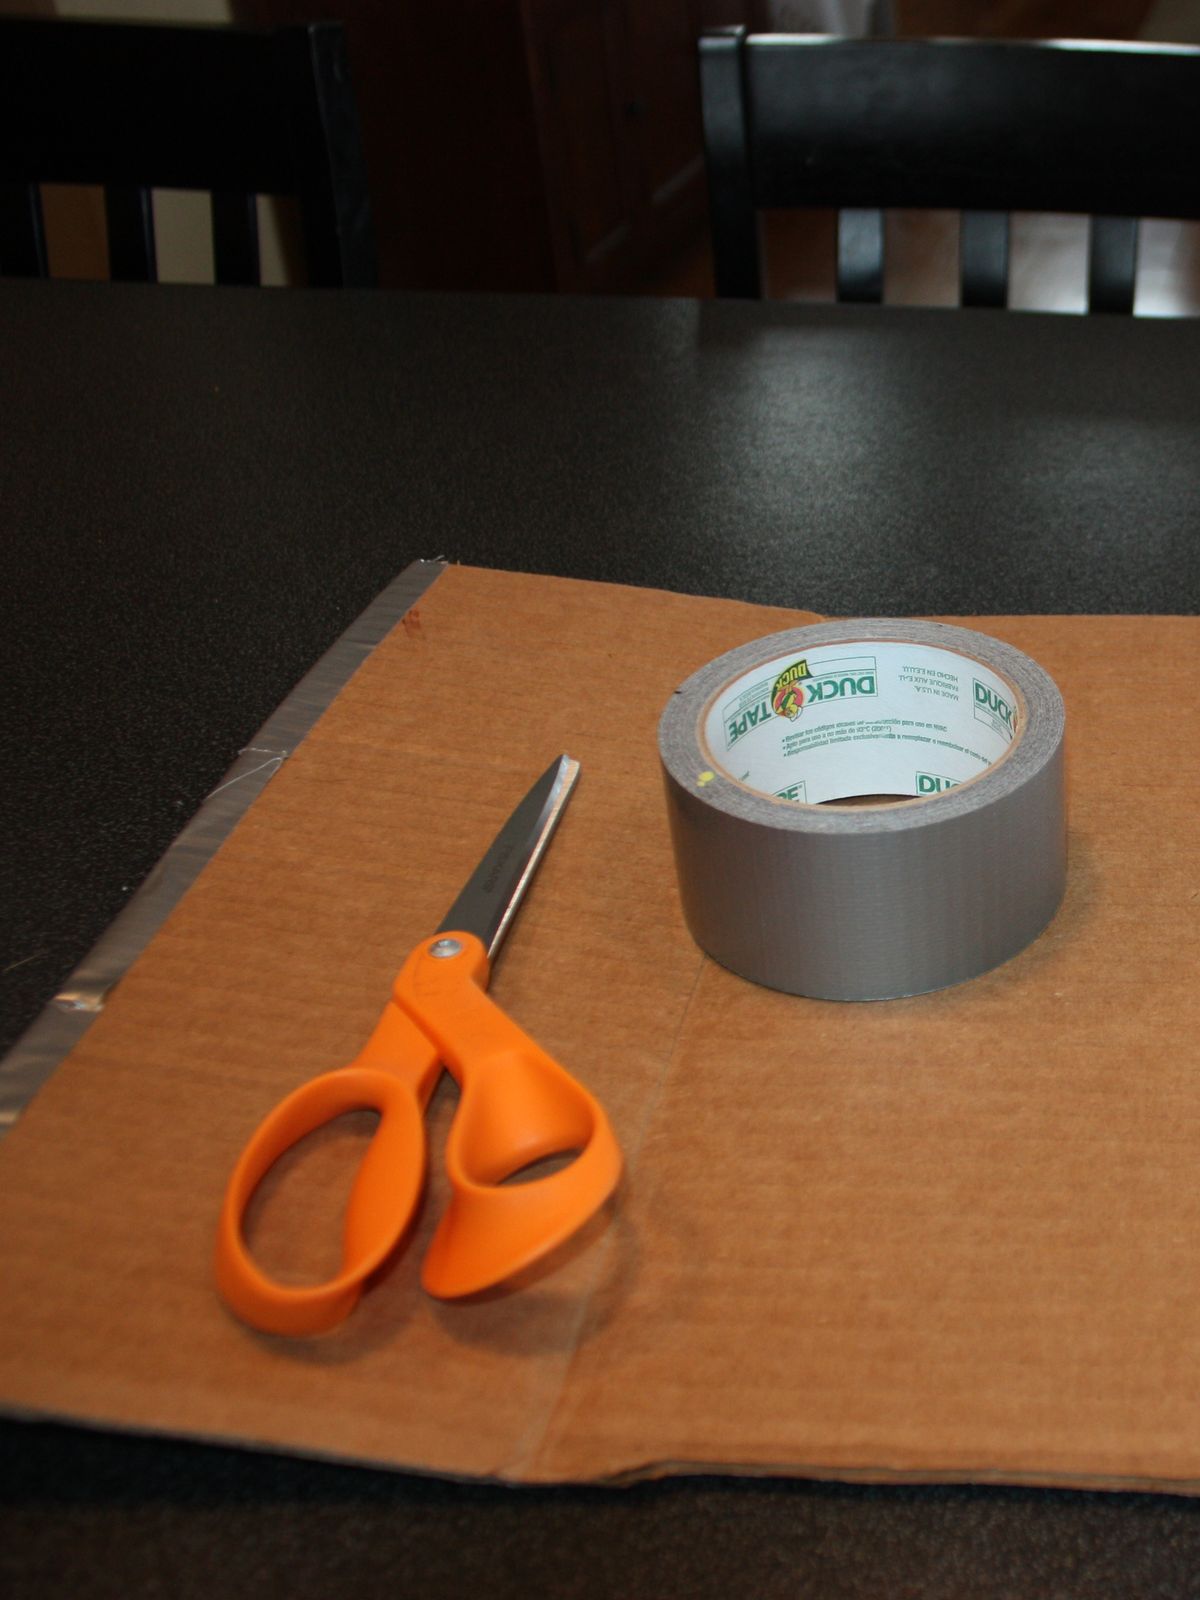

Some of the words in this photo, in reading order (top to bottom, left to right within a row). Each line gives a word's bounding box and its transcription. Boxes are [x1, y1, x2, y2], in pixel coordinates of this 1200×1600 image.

[776, 662, 807, 690] DUCK
[806, 675, 876, 703] DUCK
[941, 690, 959, 701] MADE
[975, 682, 1012, 731] DUCK
[729, 701, 772, 742] TAPE
